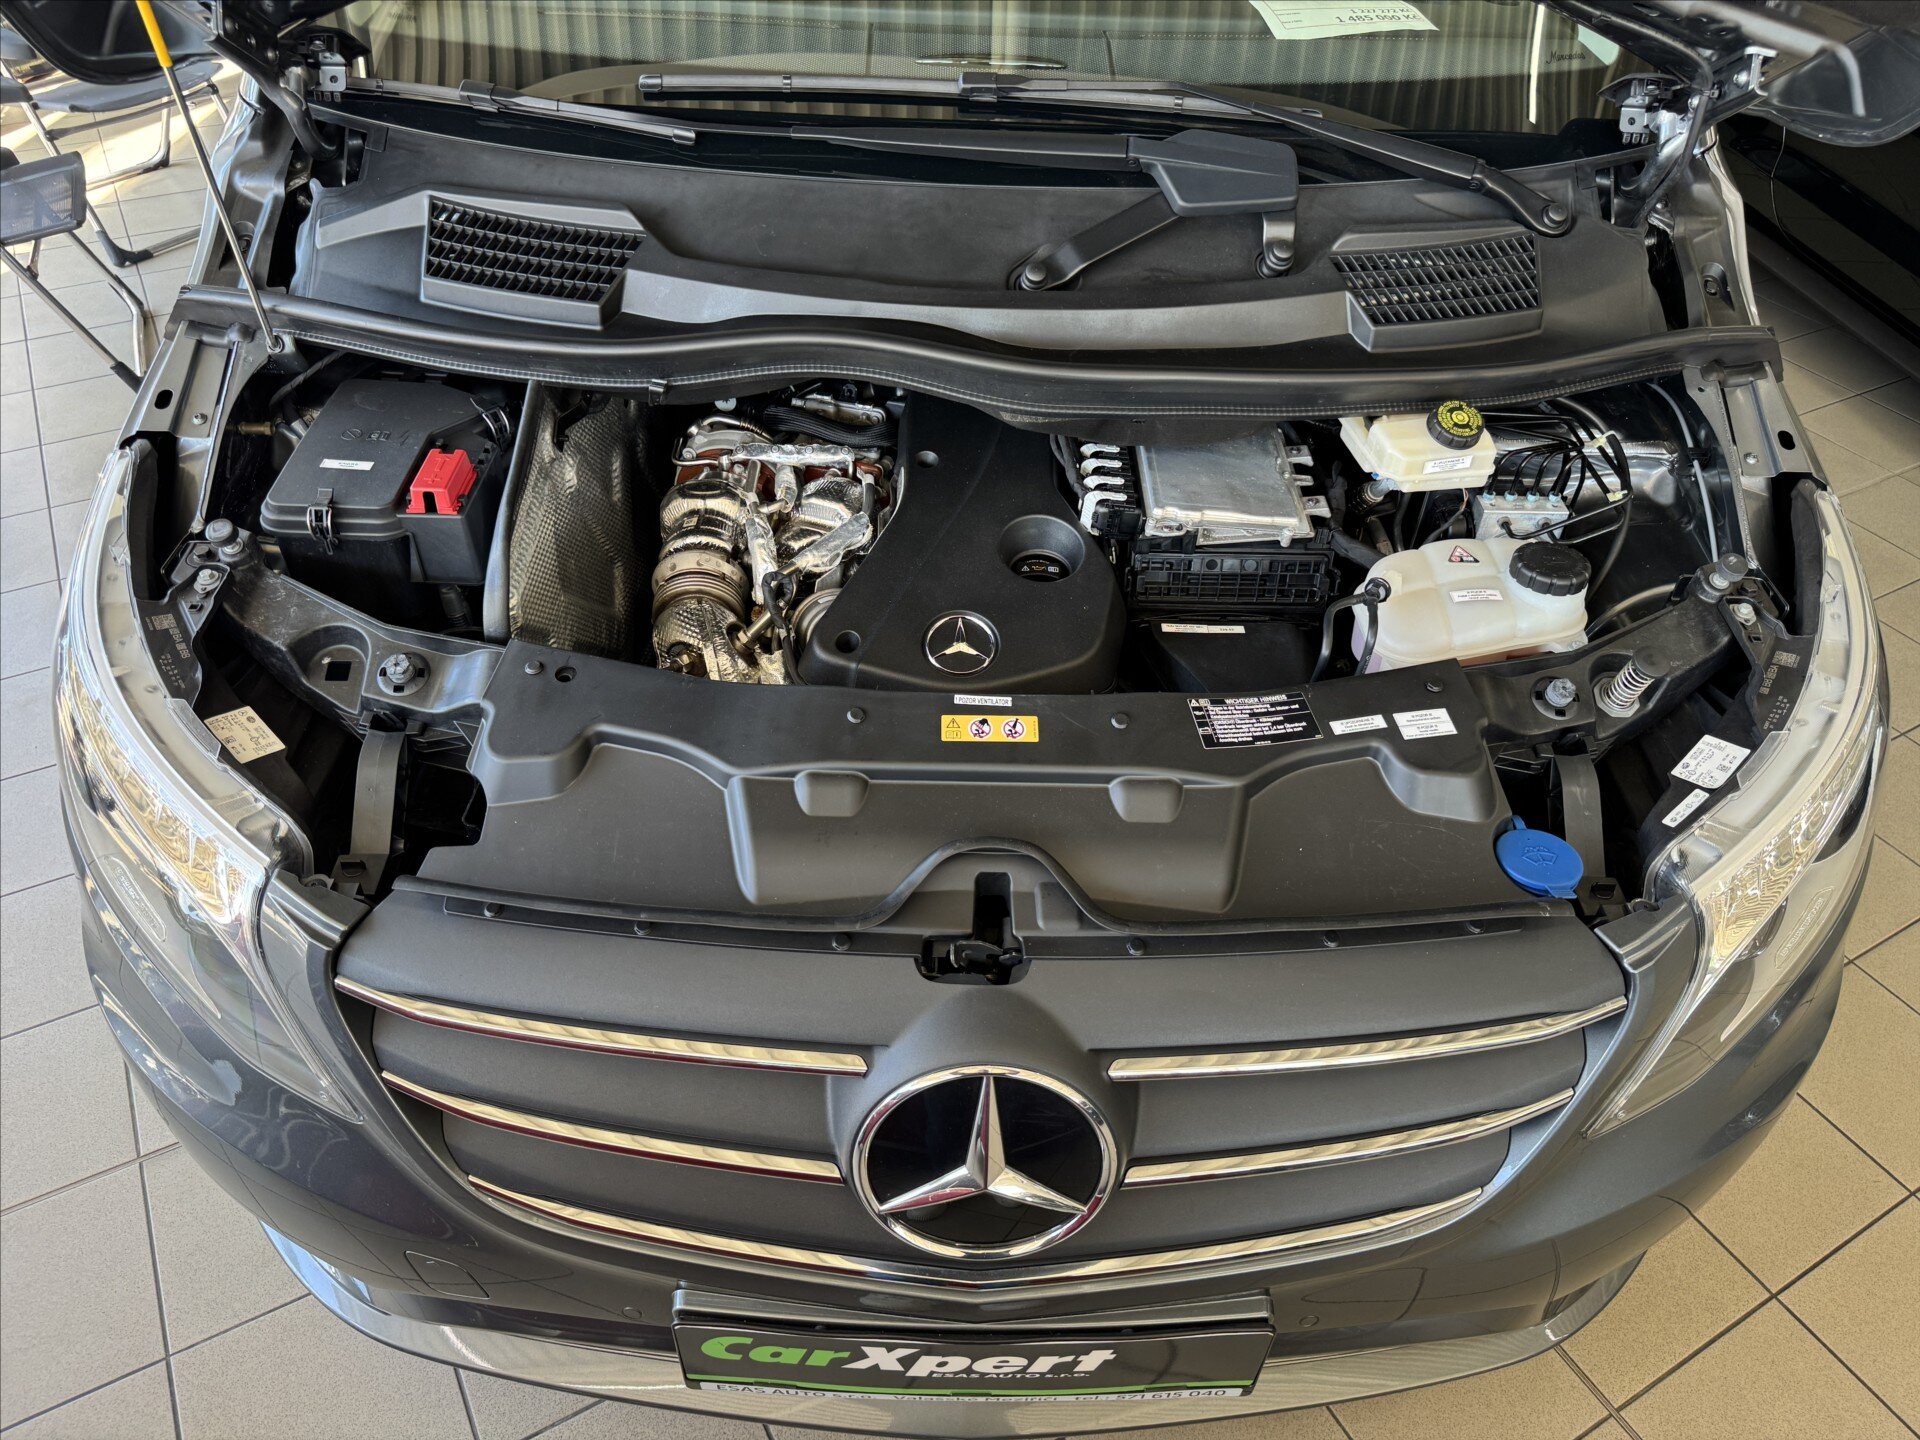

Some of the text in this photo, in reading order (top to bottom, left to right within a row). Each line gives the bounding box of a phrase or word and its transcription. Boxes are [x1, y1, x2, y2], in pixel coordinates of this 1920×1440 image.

[1224, 694, 1288, 705] WICHTIGER HINWEIS
[701, 1336, 1117, 1377] CarXpert
[716, 1384, 766, 1394] ESAS
[772, 1388, 826, 1397] AUTO
[1151, 1391, 1182, 1399] 615
[1188, 1389, 1226, 1397] 040
